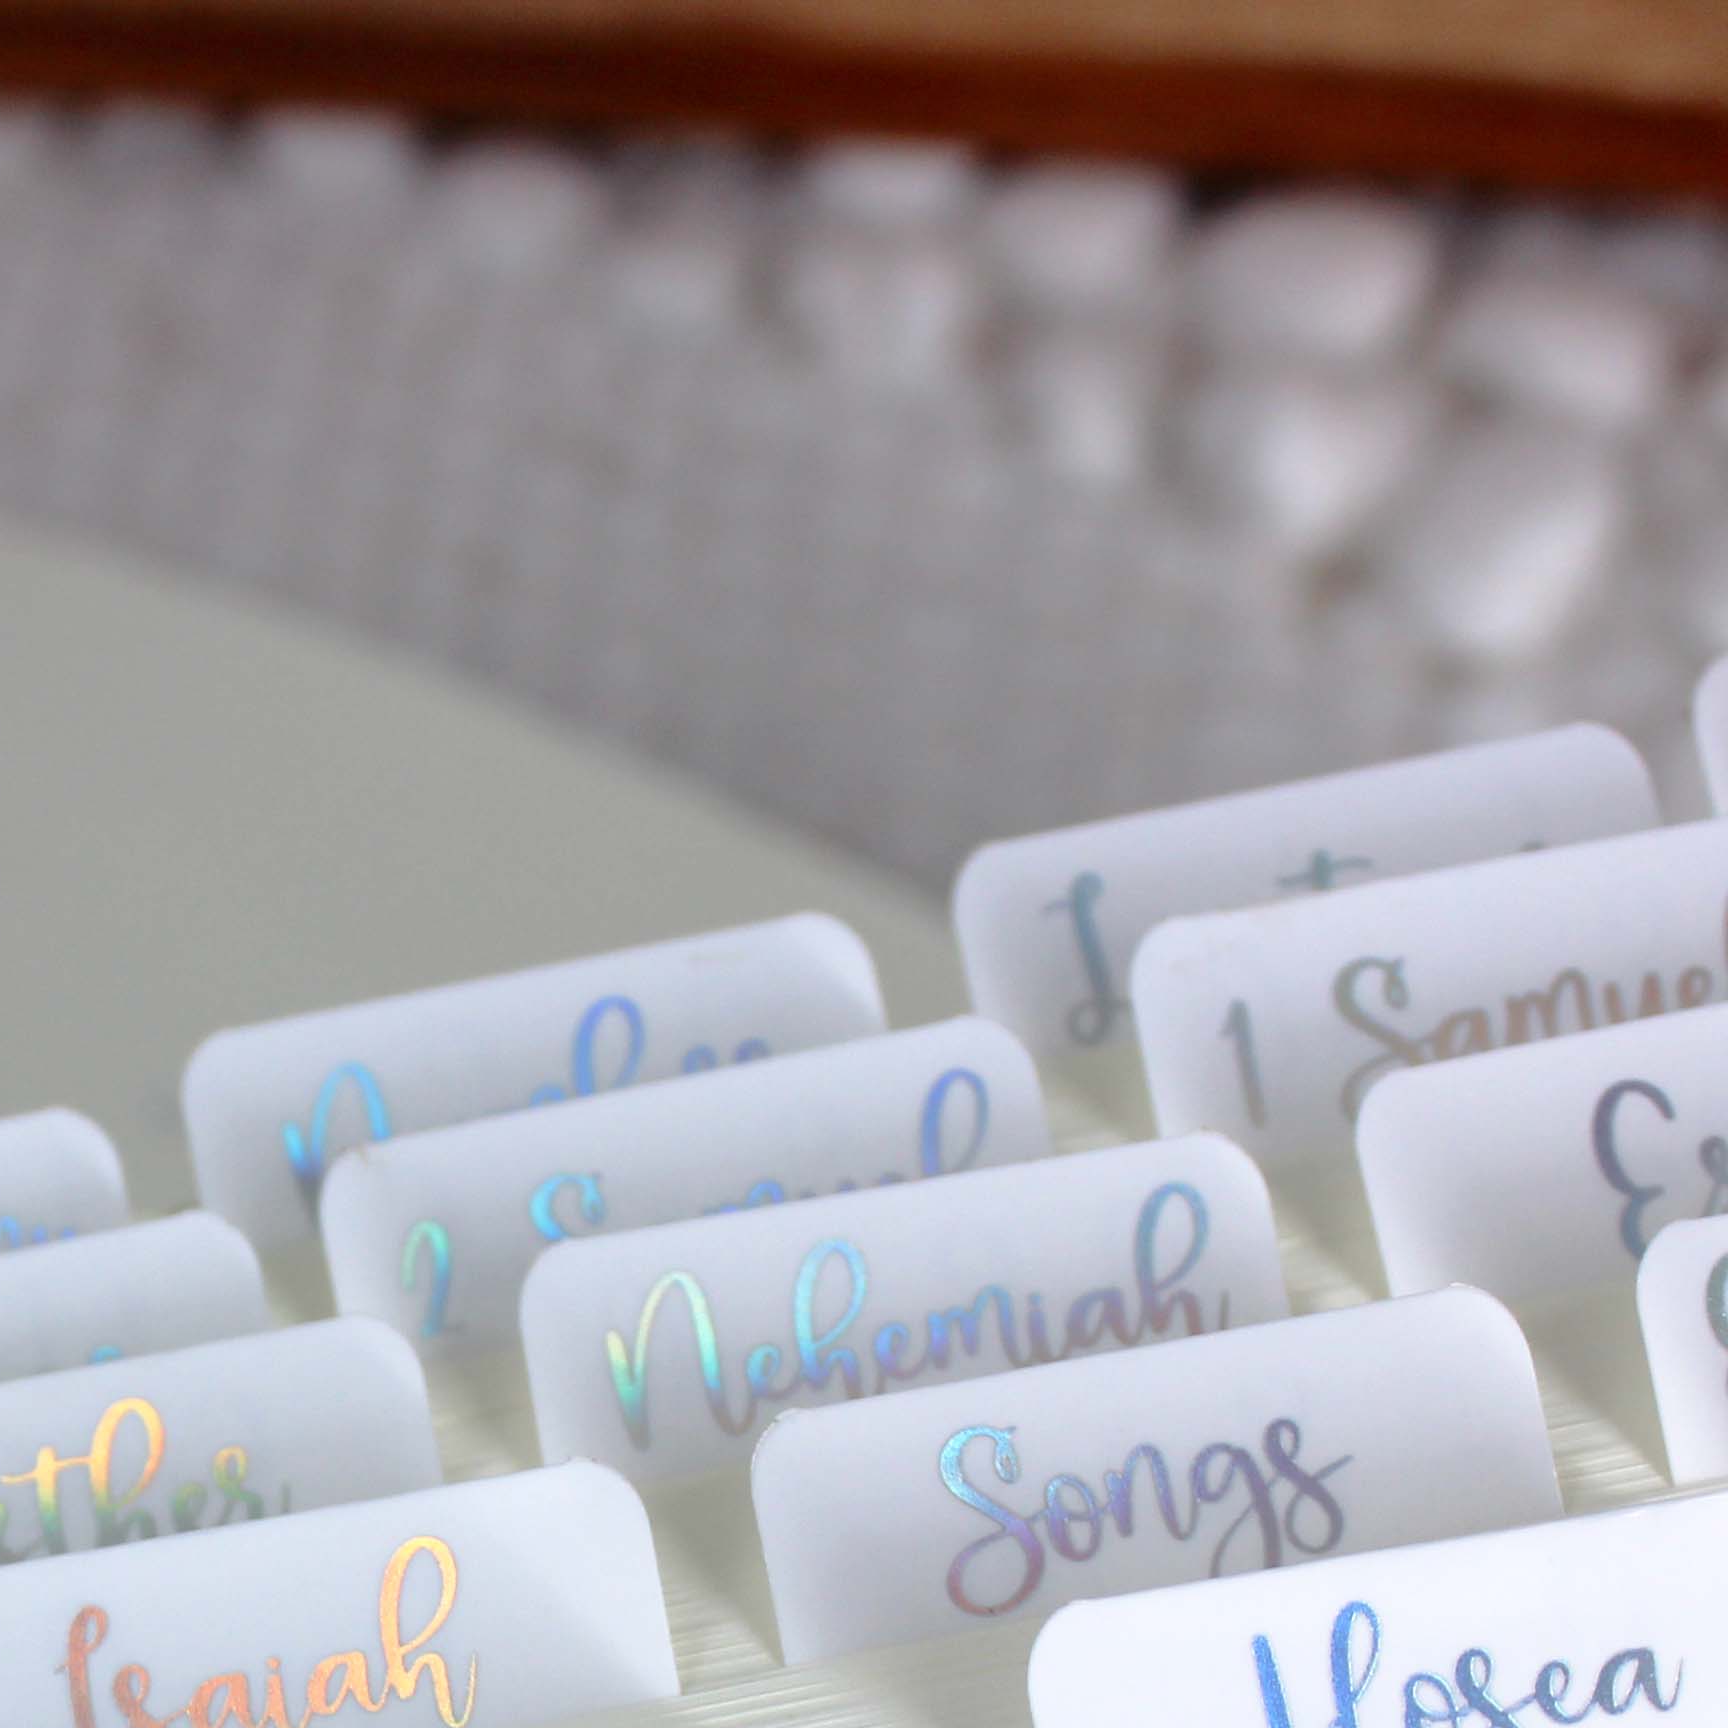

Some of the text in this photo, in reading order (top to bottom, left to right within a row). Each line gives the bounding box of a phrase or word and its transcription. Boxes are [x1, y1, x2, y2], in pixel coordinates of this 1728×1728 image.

[1332, 898, 1728, 1126] Samue
[606, 1182, 1230, 1452] Nehemiah
[939, 1418, 1354, 1616] Songs
